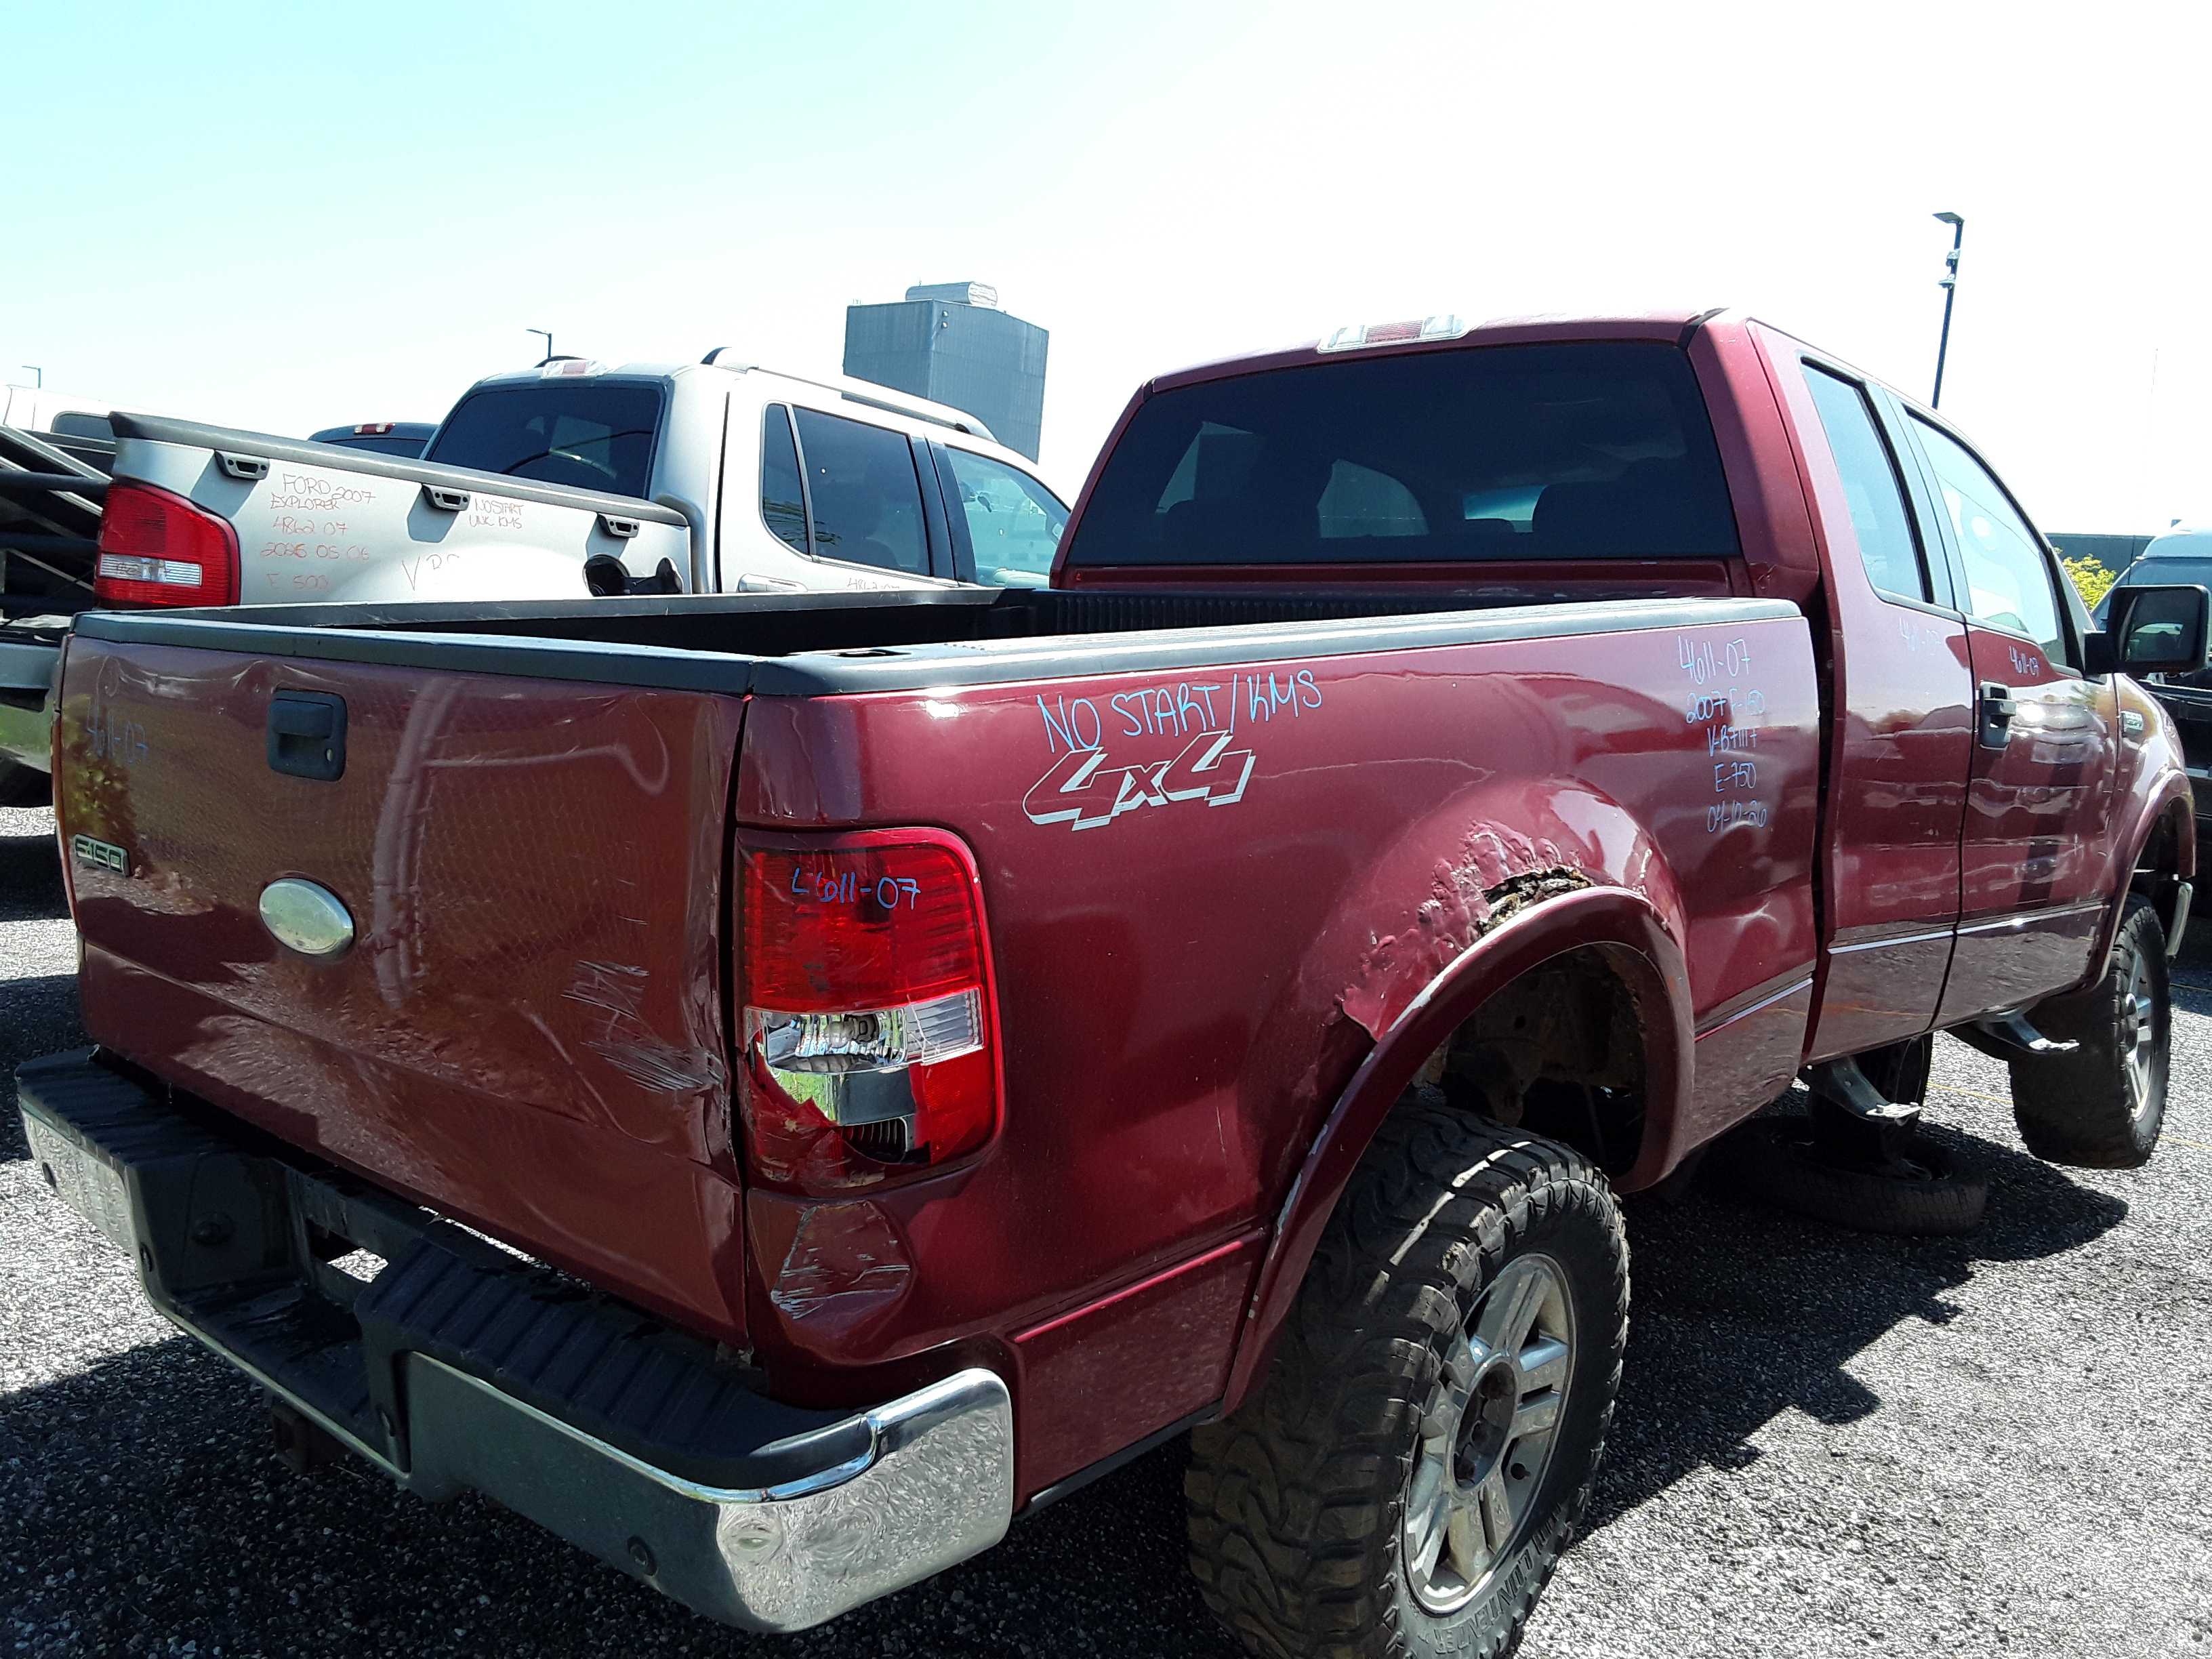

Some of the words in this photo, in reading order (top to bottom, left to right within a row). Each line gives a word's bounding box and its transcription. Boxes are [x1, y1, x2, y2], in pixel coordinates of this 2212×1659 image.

[282, 473, 331, 495] FORD
[331, 487, 376, 504] 2007
[323, 521, 349, 536] 07
[1677, 634, 1751, 685] 4611-07
[1036, 693, 1102, 754] NO
[1685, 689, 1727, 724] 2007
